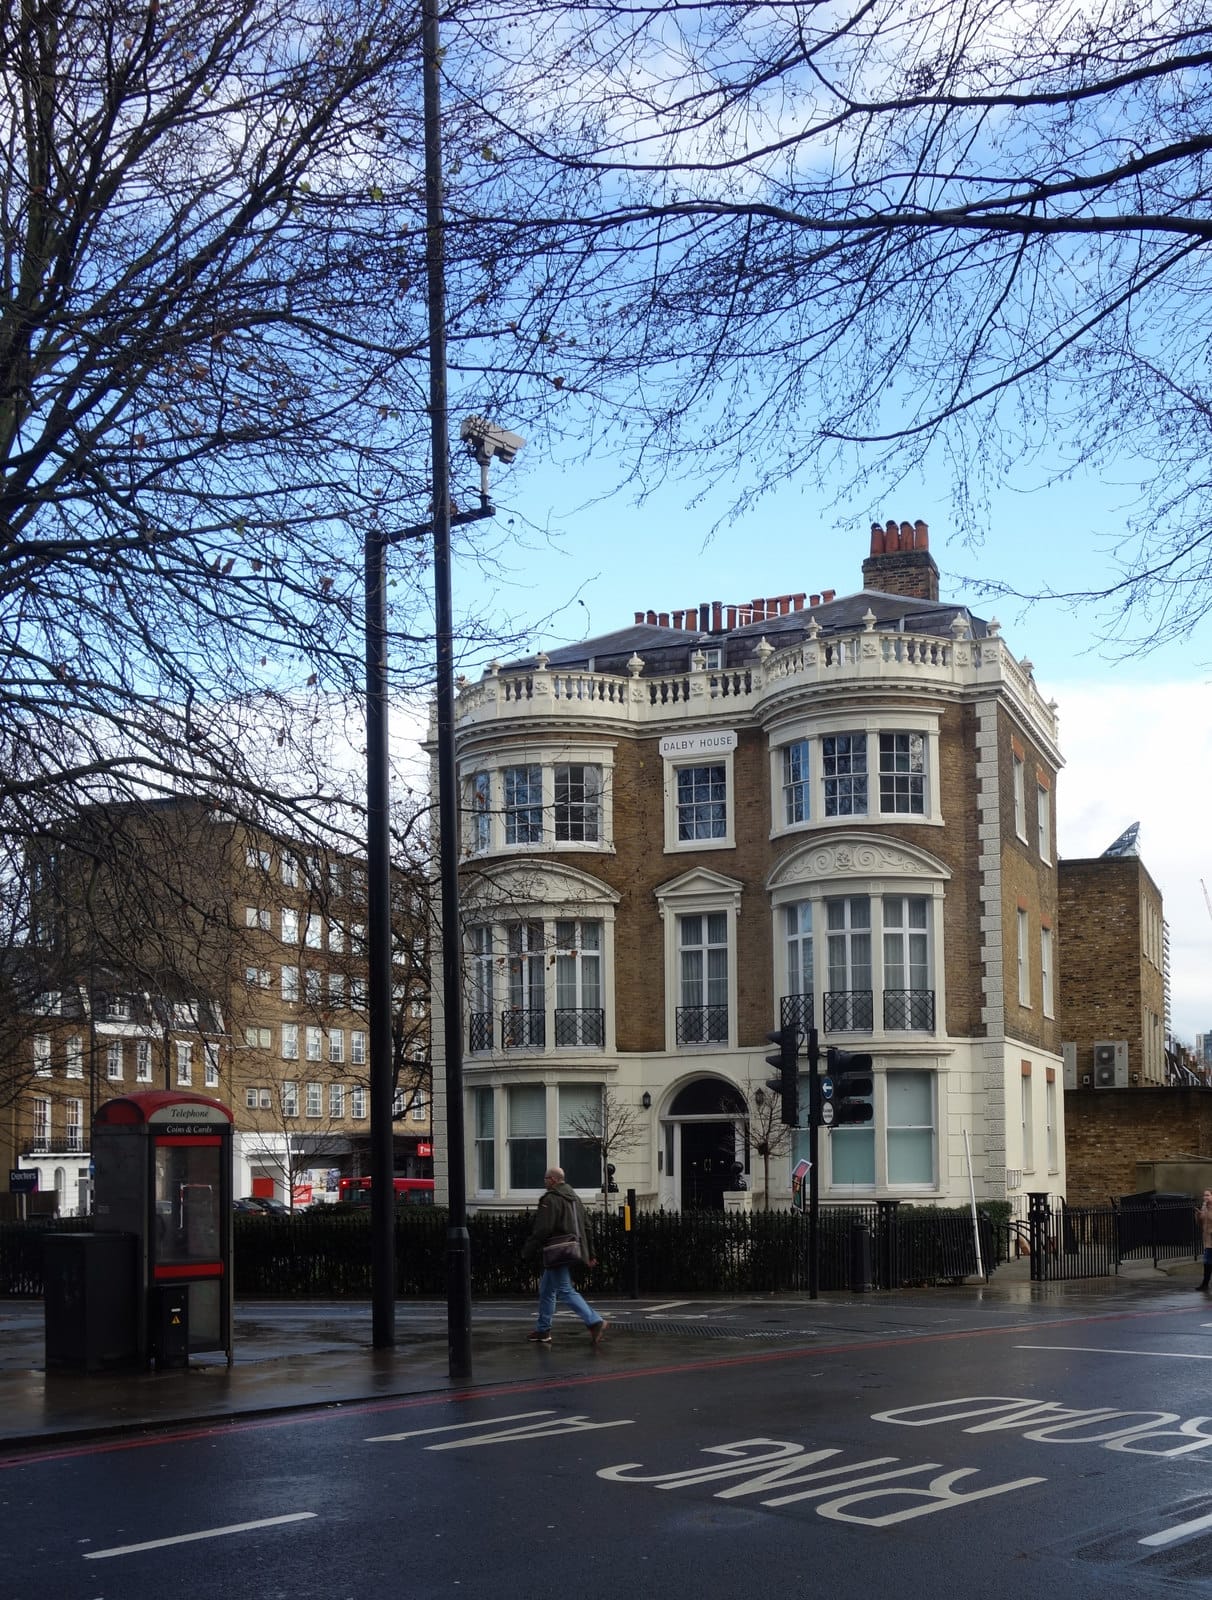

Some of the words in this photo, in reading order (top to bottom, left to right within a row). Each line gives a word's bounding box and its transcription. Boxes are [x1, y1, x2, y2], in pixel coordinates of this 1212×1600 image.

[663, 740, 695, 752] DALBY
[699, 736, 733, 748] HOUSE
[170, 1108, 209, 1118] Telephone
[166, 1125, 185, 1133] Coins
[185, 1125, 192, 1133] &
[193, 1125, 213, 1133] Cards
[595, 1437, 1049, 1527] RING
